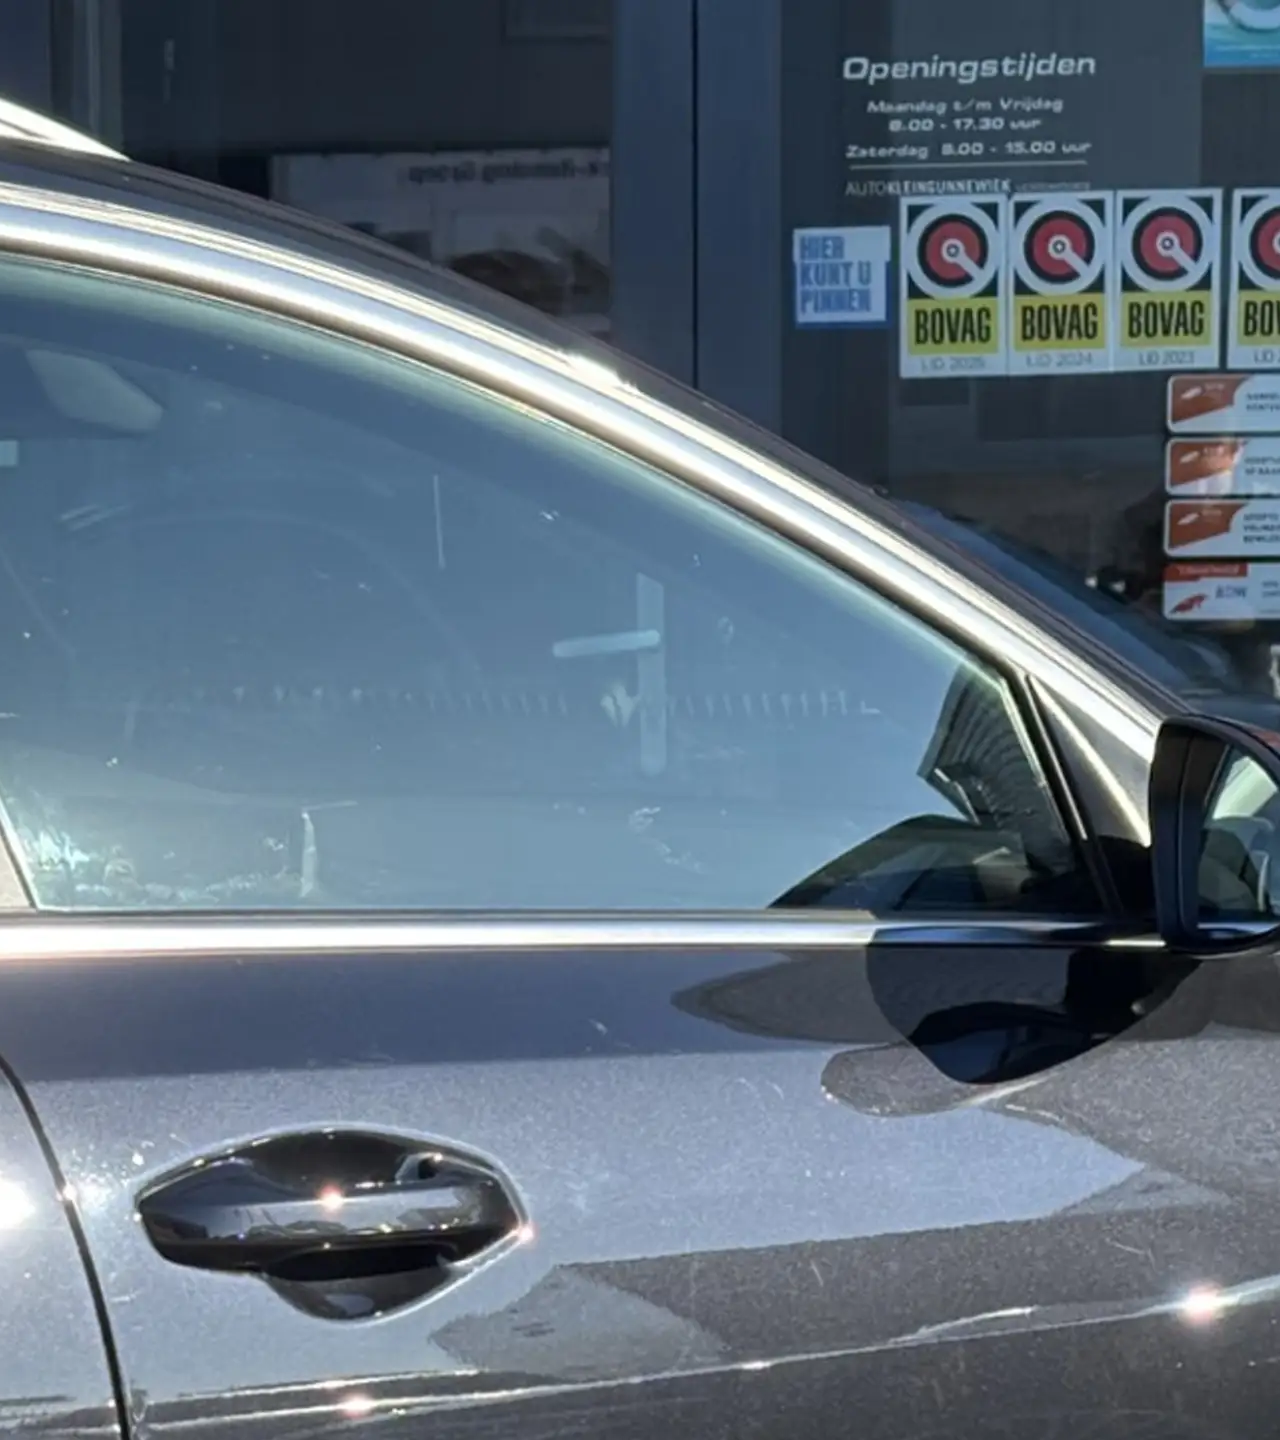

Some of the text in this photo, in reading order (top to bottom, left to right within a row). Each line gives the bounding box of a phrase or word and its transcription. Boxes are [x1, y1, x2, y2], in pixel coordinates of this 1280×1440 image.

[842, 52, 1096, 85] Openingstijden
[867, 97, 1064, 115] Maandag t/m Vrijdag
[953, 117, 1004, 131] 17.30
[1010, 119, 1042, 130] uur
[845, 145, 929, 159] Zaterdag
[1061, 142, 1092, 153] uur
[800, 236, 845, 259] HIER
[800, 260, 872, 287] KUNT U
[800, 289, 872, 314] PINNEN
[914, 307, 992, 345] BOVAG
[1021, 303, 1098, 341] BOVAG
[1128, 301, 1204, 339] BOVAG
[1139, 351, 1159, 365] LID
[1254, 350, 1275, 364] LID
